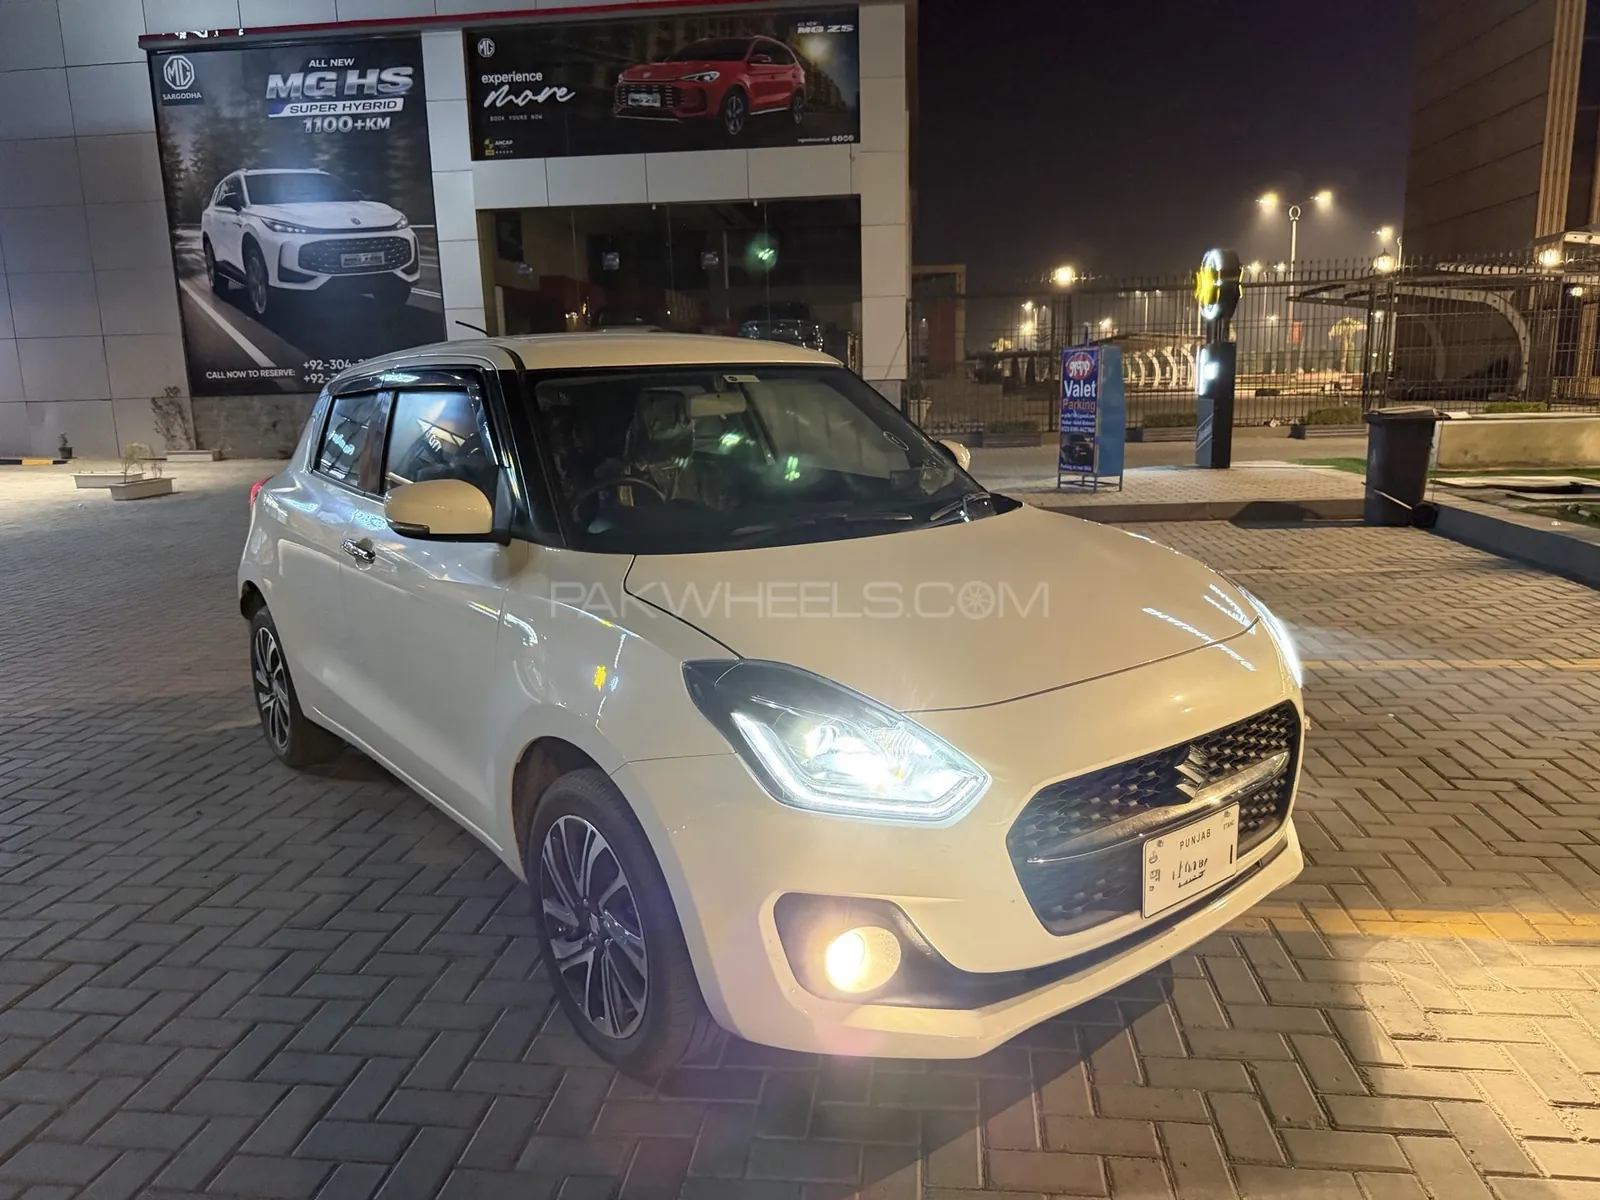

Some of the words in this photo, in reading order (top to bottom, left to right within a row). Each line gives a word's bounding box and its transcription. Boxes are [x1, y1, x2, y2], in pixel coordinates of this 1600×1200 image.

[827, 24, 854, 32] ZS
[478, 40, 494, 56] MG
[308, 59, 328, 68] ALL
[330, 58, 355, 67] NEW
[164, 59, 193, 87] MG
[481, 71, 543, 85] experience
[265, 71, 338, 99] MG
[344, 66, 415, 96] HS
[162, 92, 202, 100] SARGODHA
[483, 84, 576, 108] more
[289, 103, 338, 114] SUPER
[341, 100, 398, 112] HYBRID
[303, 116, 391, 133] 1100+KM
[206, 371, 225, 379] CALL
[226, 370, 247, 378] NOW
[248, 370, 259, 378] TO
[260, 369, 295, 377] RESERVE:
[1063, 380, 1096, 397] Valet
[1062, 399, 1096, 413] Parking
[1179, 828, 1212, 850] PUNJAB
